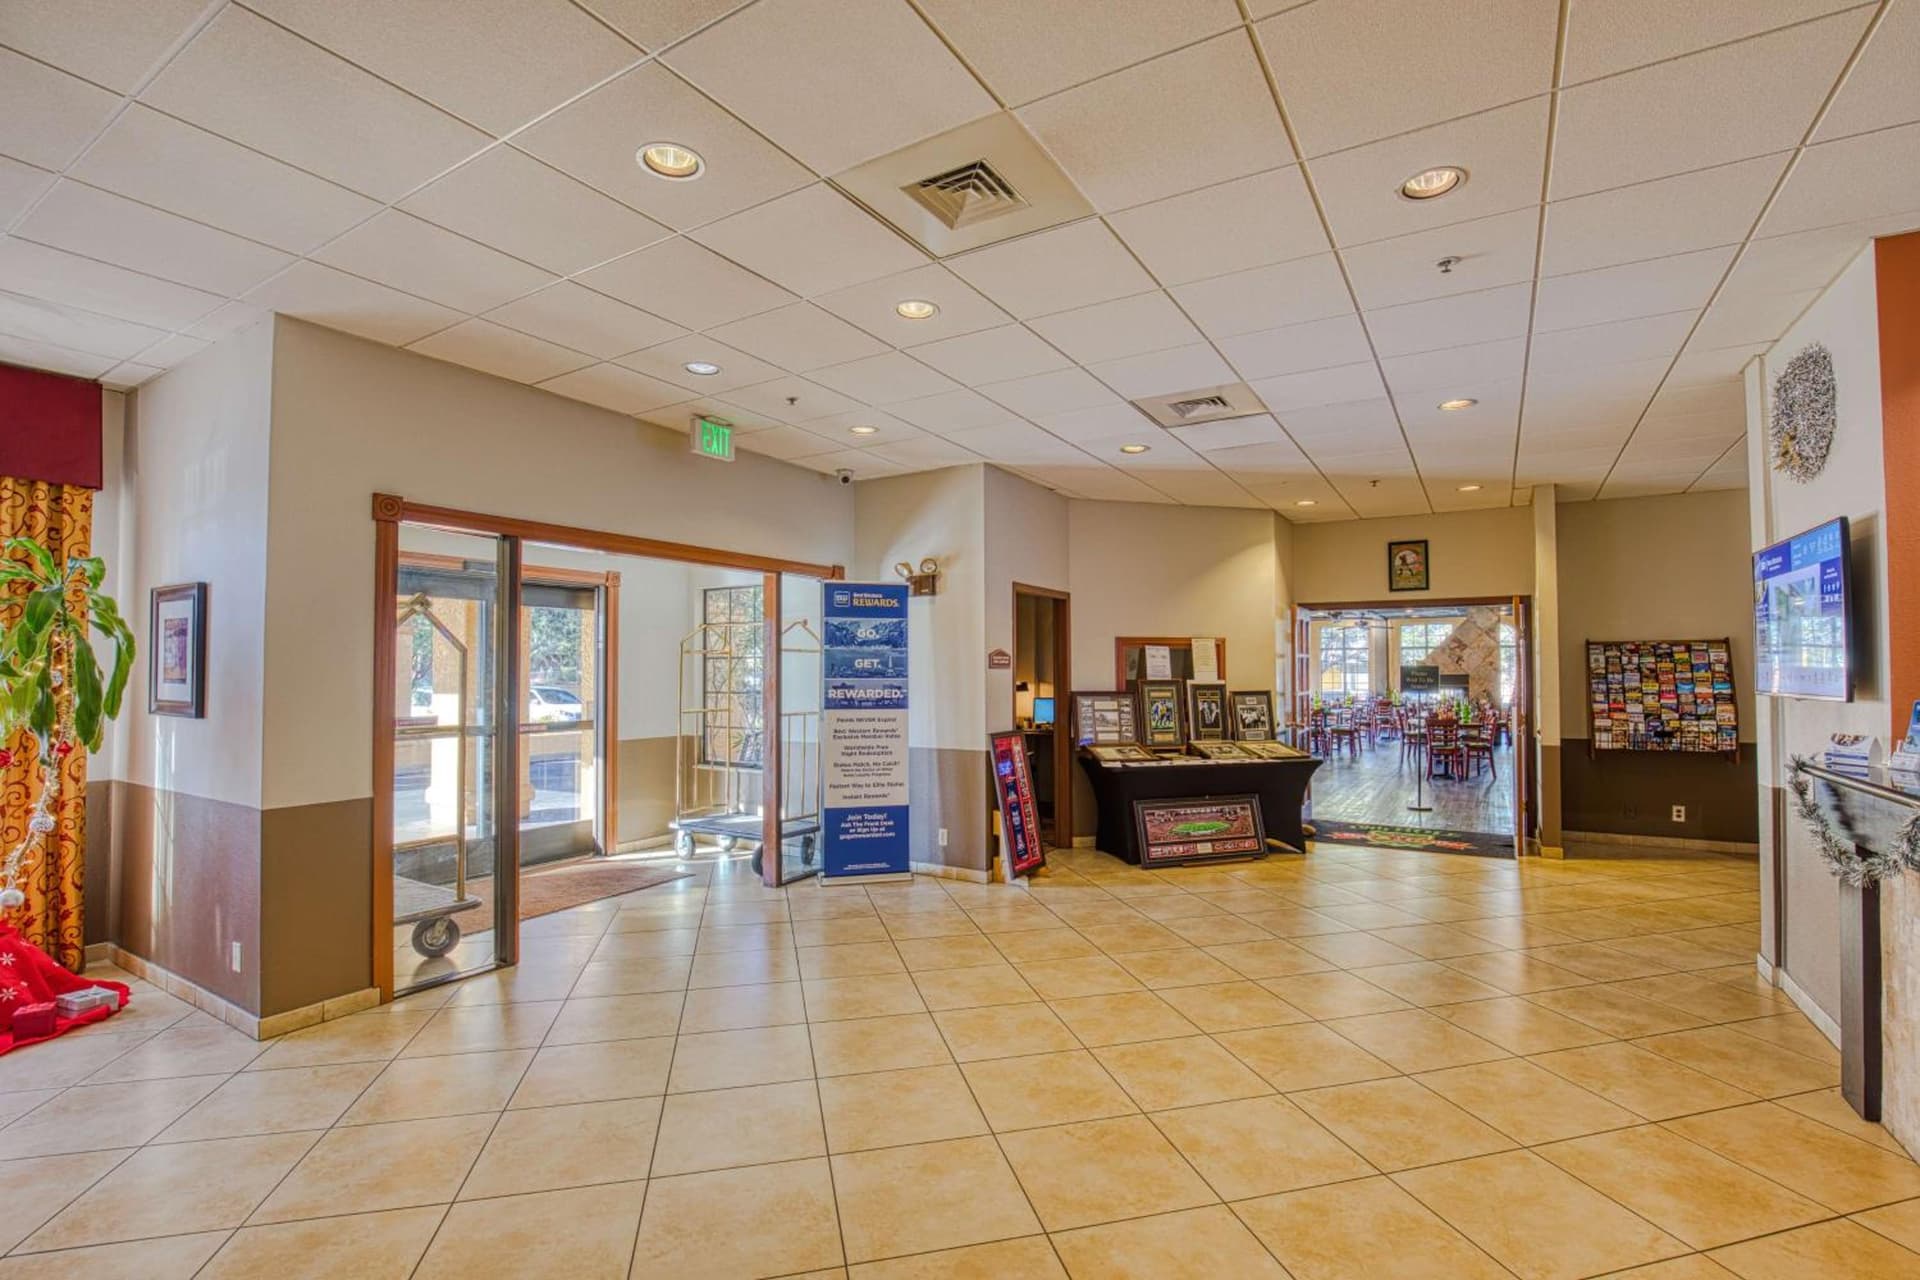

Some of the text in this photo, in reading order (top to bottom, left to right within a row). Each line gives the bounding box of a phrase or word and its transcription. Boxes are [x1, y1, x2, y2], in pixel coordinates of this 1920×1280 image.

[703, 421, 732, 458] EXIT
[853, 598, 898, 608] REWARDS
[857, 628, 880, 639] GO.
[854, 658, 881, 669] GET.
